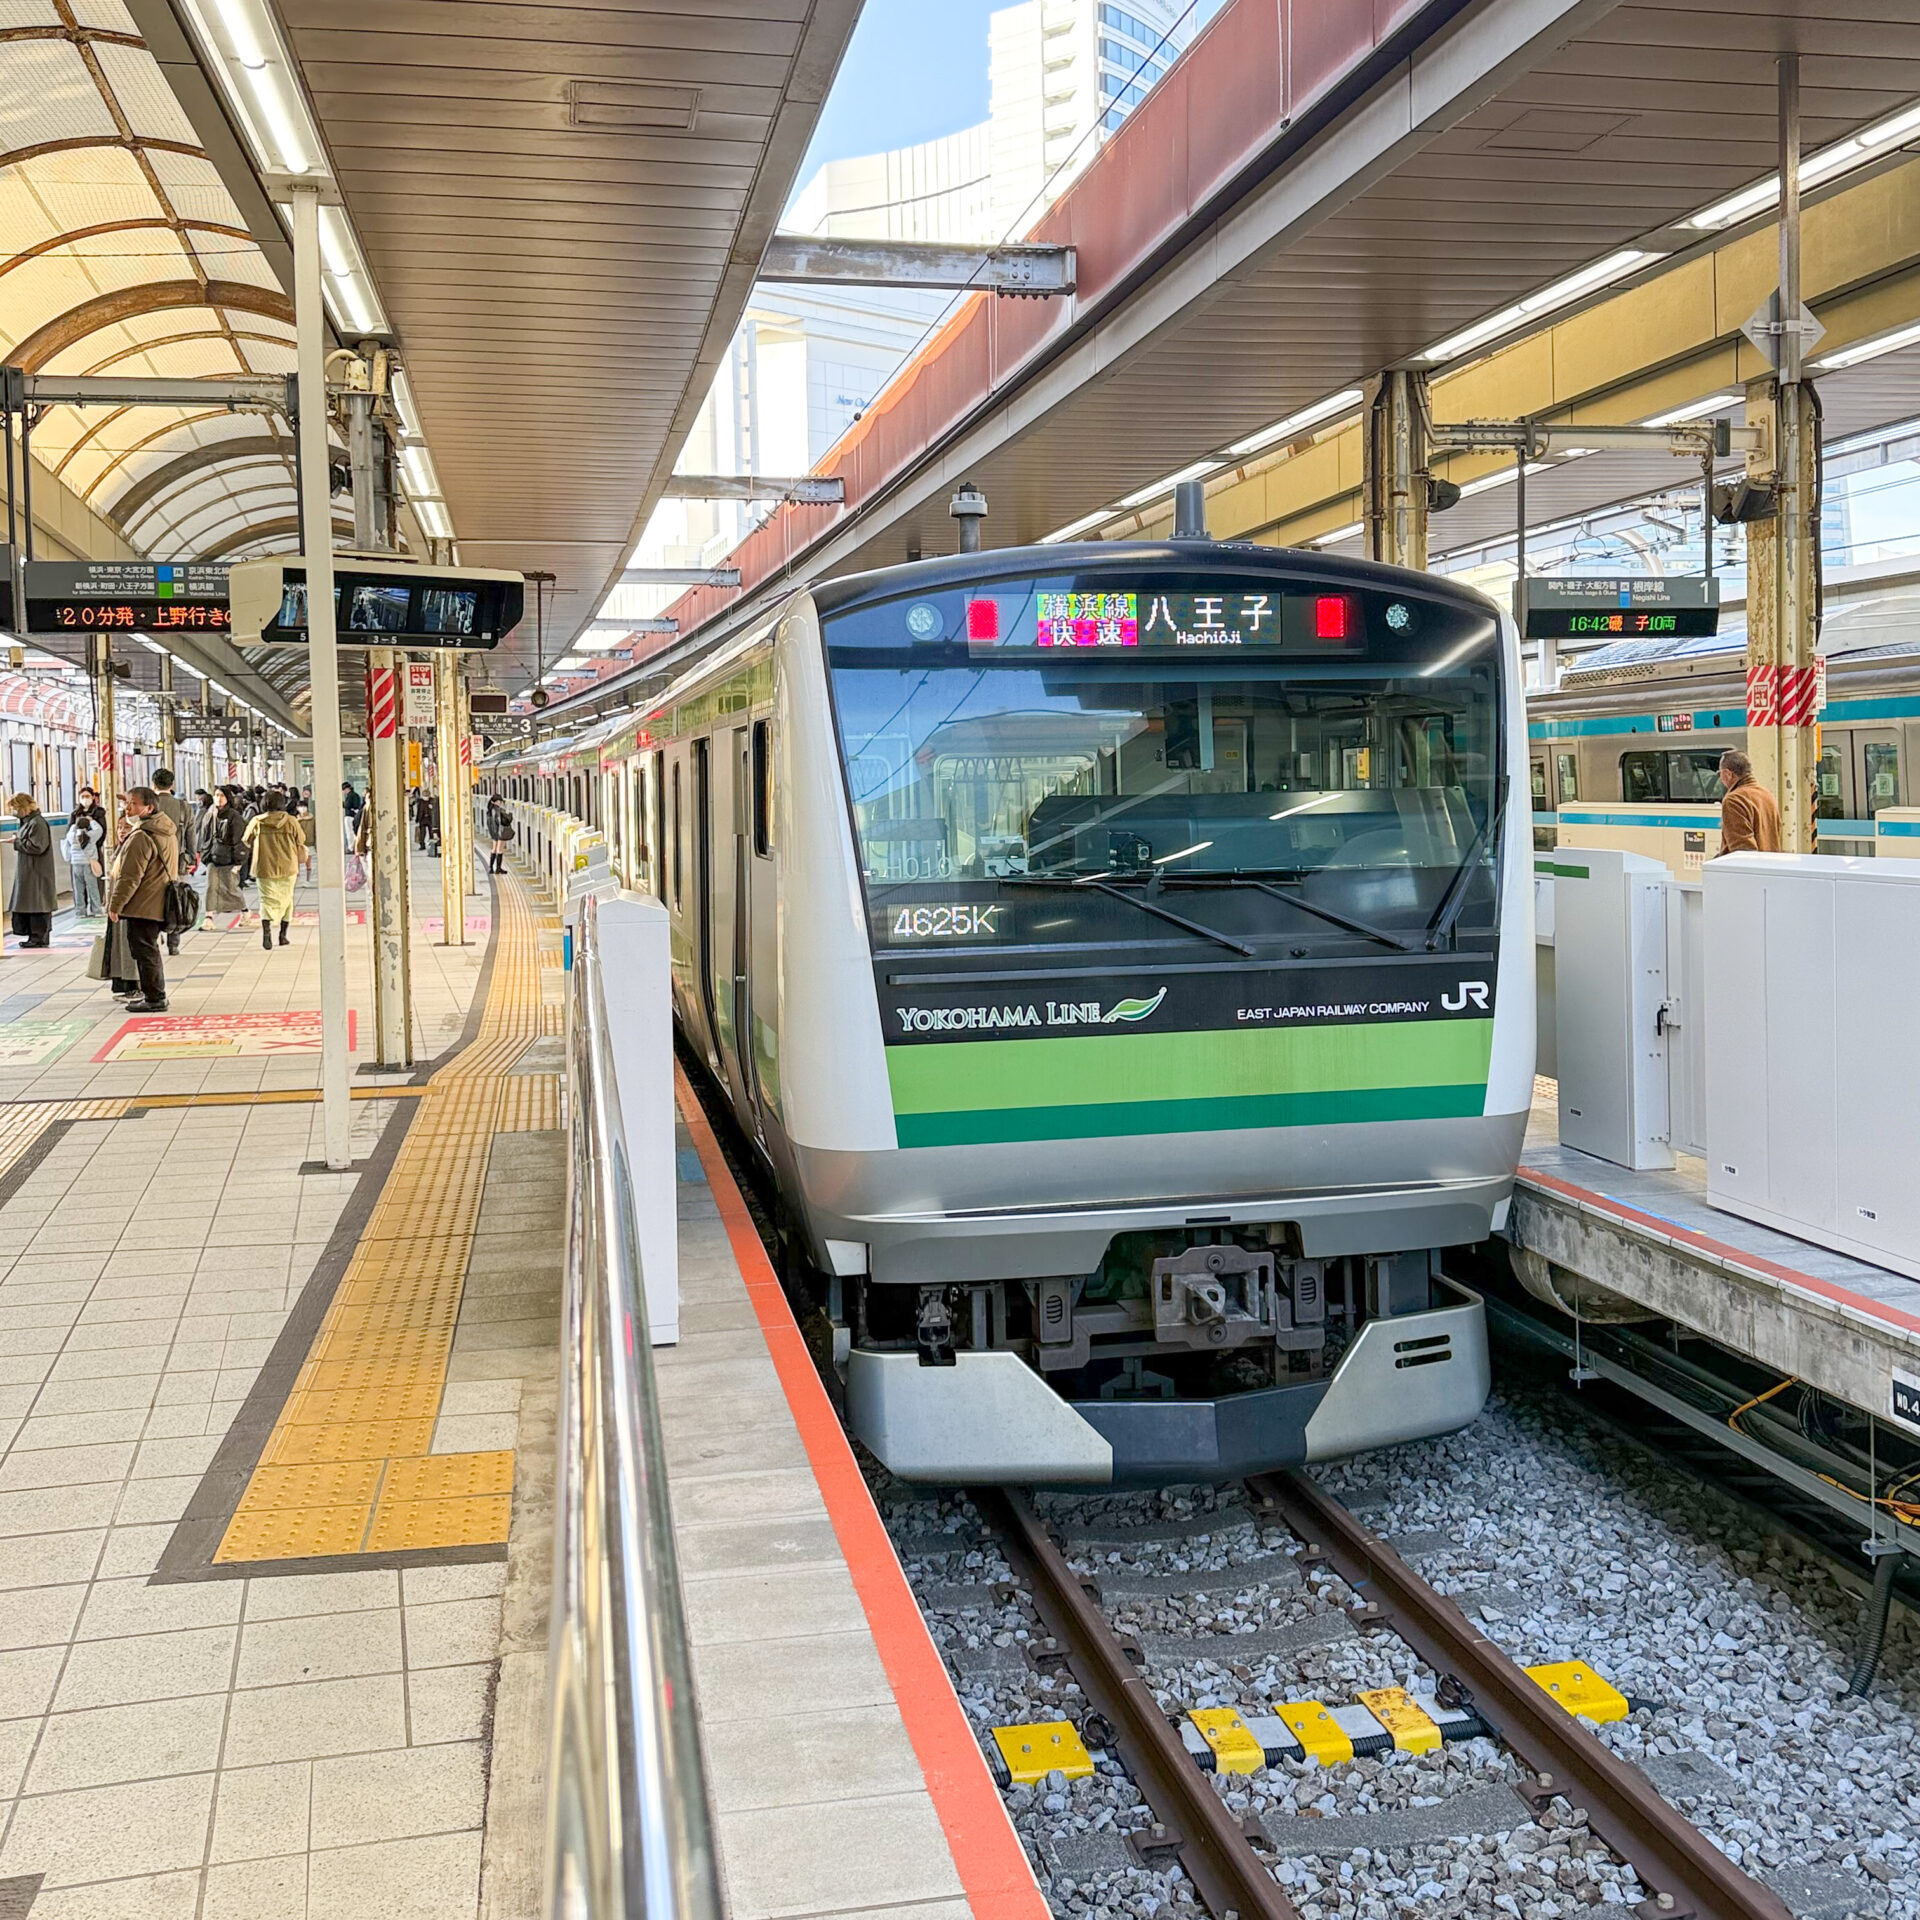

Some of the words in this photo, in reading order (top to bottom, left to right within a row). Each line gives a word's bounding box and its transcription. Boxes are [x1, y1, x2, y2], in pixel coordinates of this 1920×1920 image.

[1633, 581, 1665, 592] 根岸線
[1700, 581, 1709, 604] 1
[1046, 594, 1130, 620] 横浜線
[1632, 593, 1656, 602] Negishi
[1657, 593, 1671, 601] Line
[1145, 596, 1273, 631] 八王子
[1570, 616, 1609, 632] 16:42
[229, 720, 242, 735] 4
[520, 718, 532, 733] 3
[894, 905, 996, 936] 4625K
[1441, 981, 1489, 1011] JR
[897, 1004, 1041, 1031] YOKOHAMA
[1046, 1001, 1100, 1024] LINE
[1237, 1007, 1272, 1021] EAST
[1273, 1005, 1317, 1018] JAPAN
[1317, 1003, 1367, 1017] RAILWAY
[1369, 1001, 1430, 1014] COMPANY
